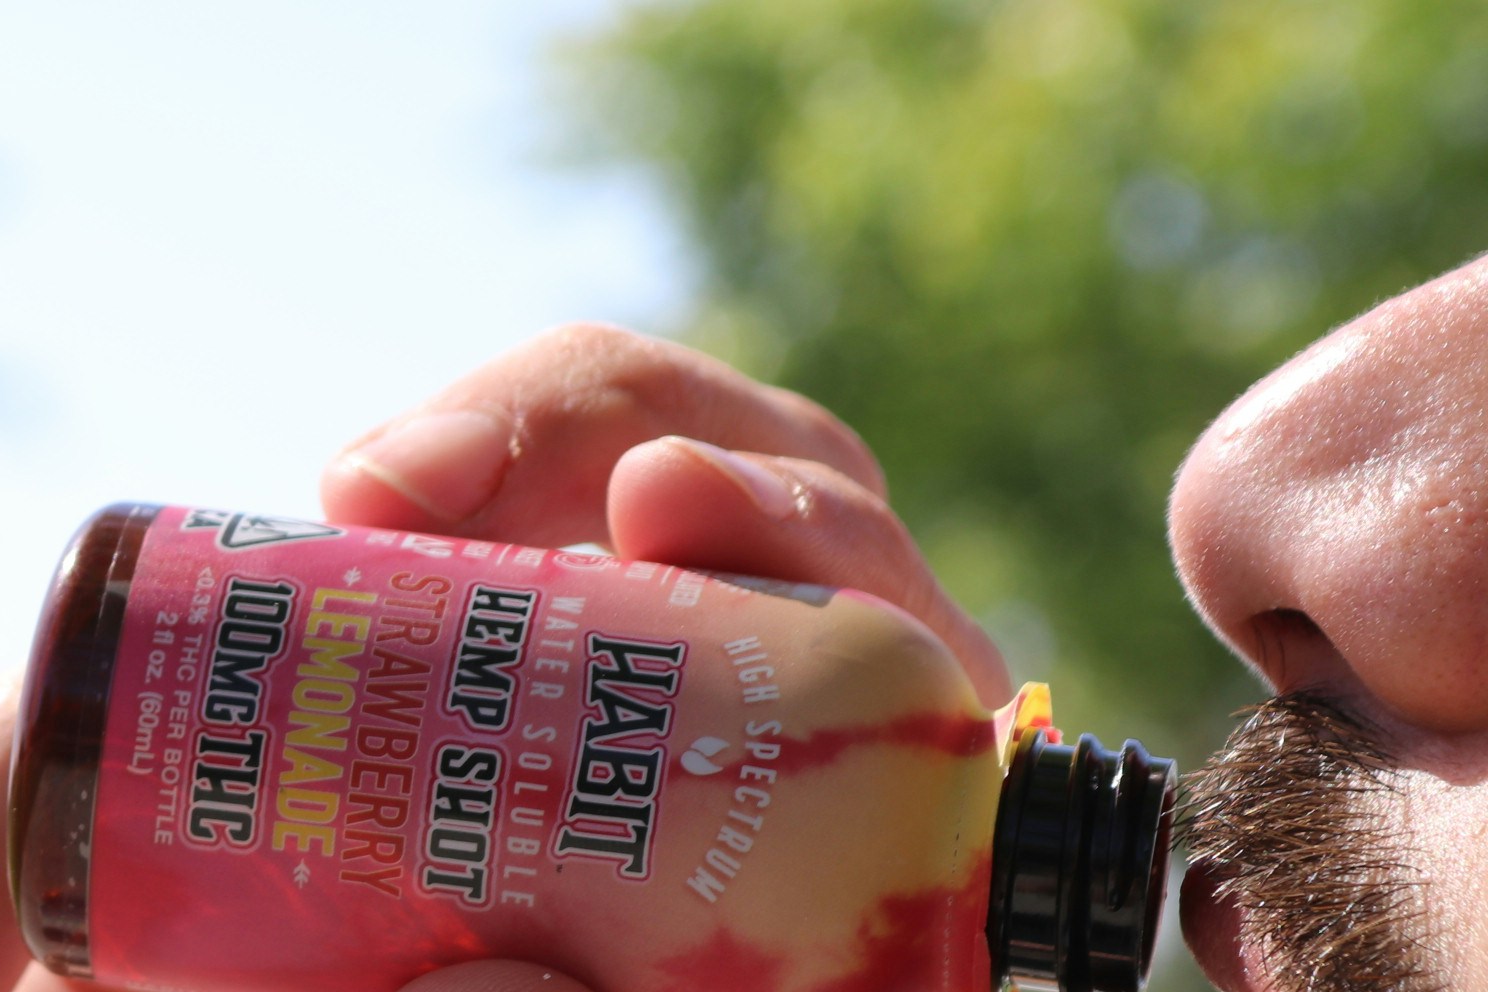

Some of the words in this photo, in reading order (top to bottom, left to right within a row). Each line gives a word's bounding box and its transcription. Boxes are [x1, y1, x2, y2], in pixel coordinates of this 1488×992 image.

[144, 650, 166, 684] oz.
[152, 629, 175, 645] fl
[155, 610, 179, 625] 2
[177, 633, 204, 682] THC
[203, 576, 296, 726] 100MG
[447, 585, 537, 732] HEMP
[529, 595, 586, 700] WATER
[723, 634, 781, 704] HIGH
[126, 691, 164, 775] (60mL)
[166, 690, 192, 740] PER
[272, 587, 378, 857] LEMONADE
[338, 570, 454, 898] STRAWBERRY
[556, 633, 686, 878] HABIT
[153, 748, 183, 845] BOTTLE
[188, 728, 267, 844] THC
[424, 747, 502, 903] SHOT
[501, 722, 557, 908] SOLUBLE
[686, 719, 783, 903] SPECTRUM
